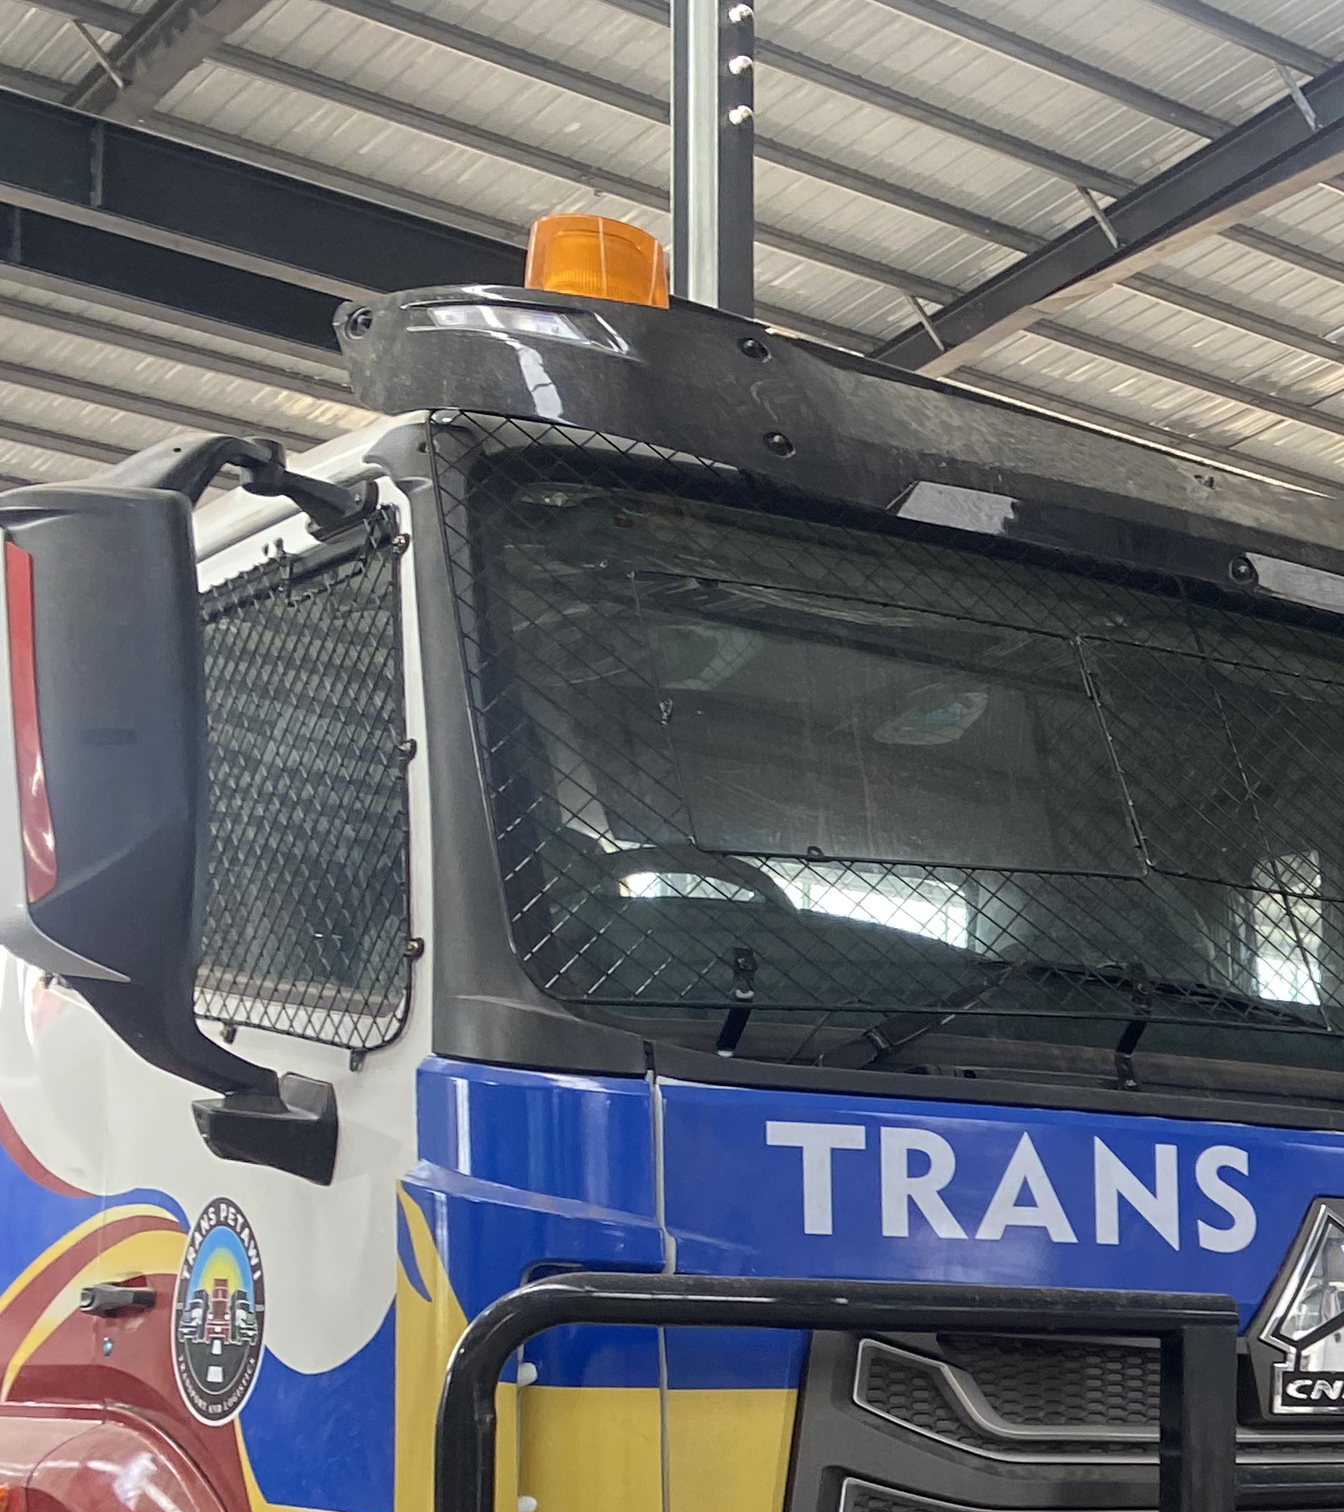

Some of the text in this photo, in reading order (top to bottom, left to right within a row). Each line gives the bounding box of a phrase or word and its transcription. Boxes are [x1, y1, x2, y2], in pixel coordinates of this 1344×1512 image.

[766, 1120, 1256, 1254] TRANS
[182, 1203, 261, 1280] TRANS PETAWI
